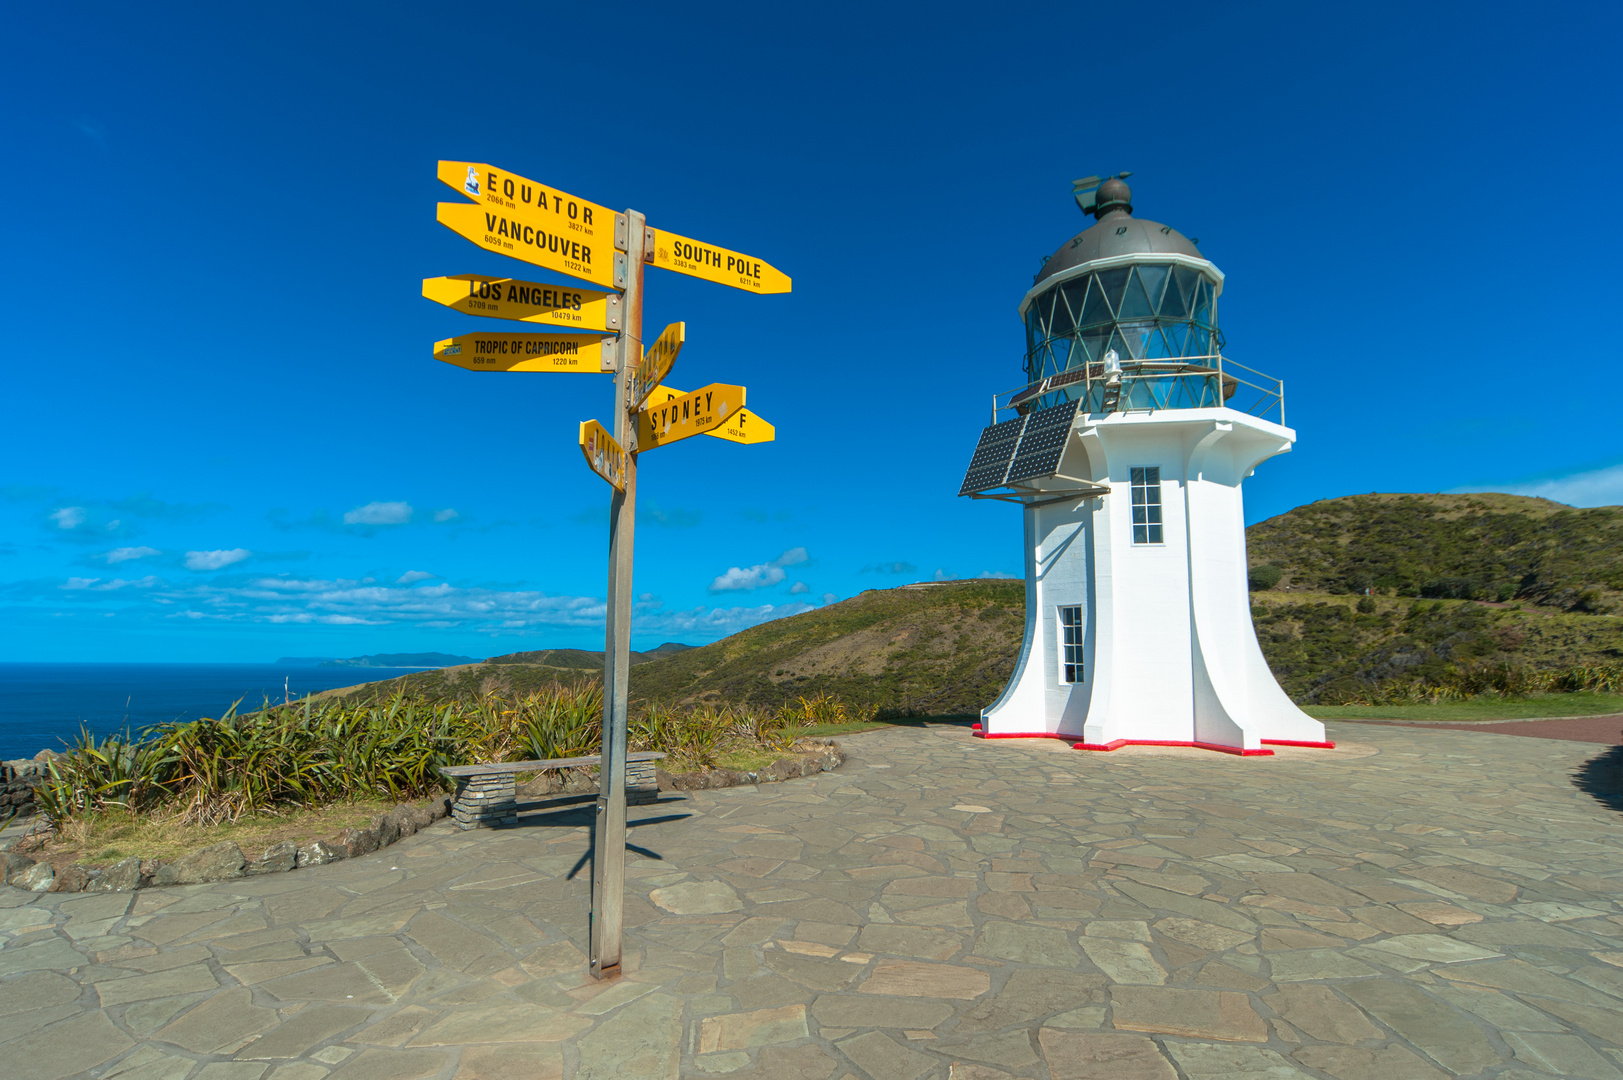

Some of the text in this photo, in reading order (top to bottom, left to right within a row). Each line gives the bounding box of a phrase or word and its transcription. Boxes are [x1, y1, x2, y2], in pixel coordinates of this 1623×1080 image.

[487, 172, 593, 226] EQUATOR
[487, 193, 516, 210] 2066 nm
[568, 221, 593, 236] 3827 km
[484, 234, 514, 250] 6059 nm
[486, 212, 592, 264] VANCOUVER
[564, 260, 592, 274] 11222 km
[674, 241, 721, 268] SOUTH
[728, 256, 760, 279] POLE
[470, 280, 582, 311] LOS ANGELES
[552, 310, 582, 322] 10479 km
[475, 340, 509, 354] TROPIC
[511, 341, 522, 354] OF
[526, 341, 578, 355] CAPRICORN
[652, 391, 713, 431] SYDNEY
[706, 416, 712, 424] km
[727, 428, 738, 436] 1452
